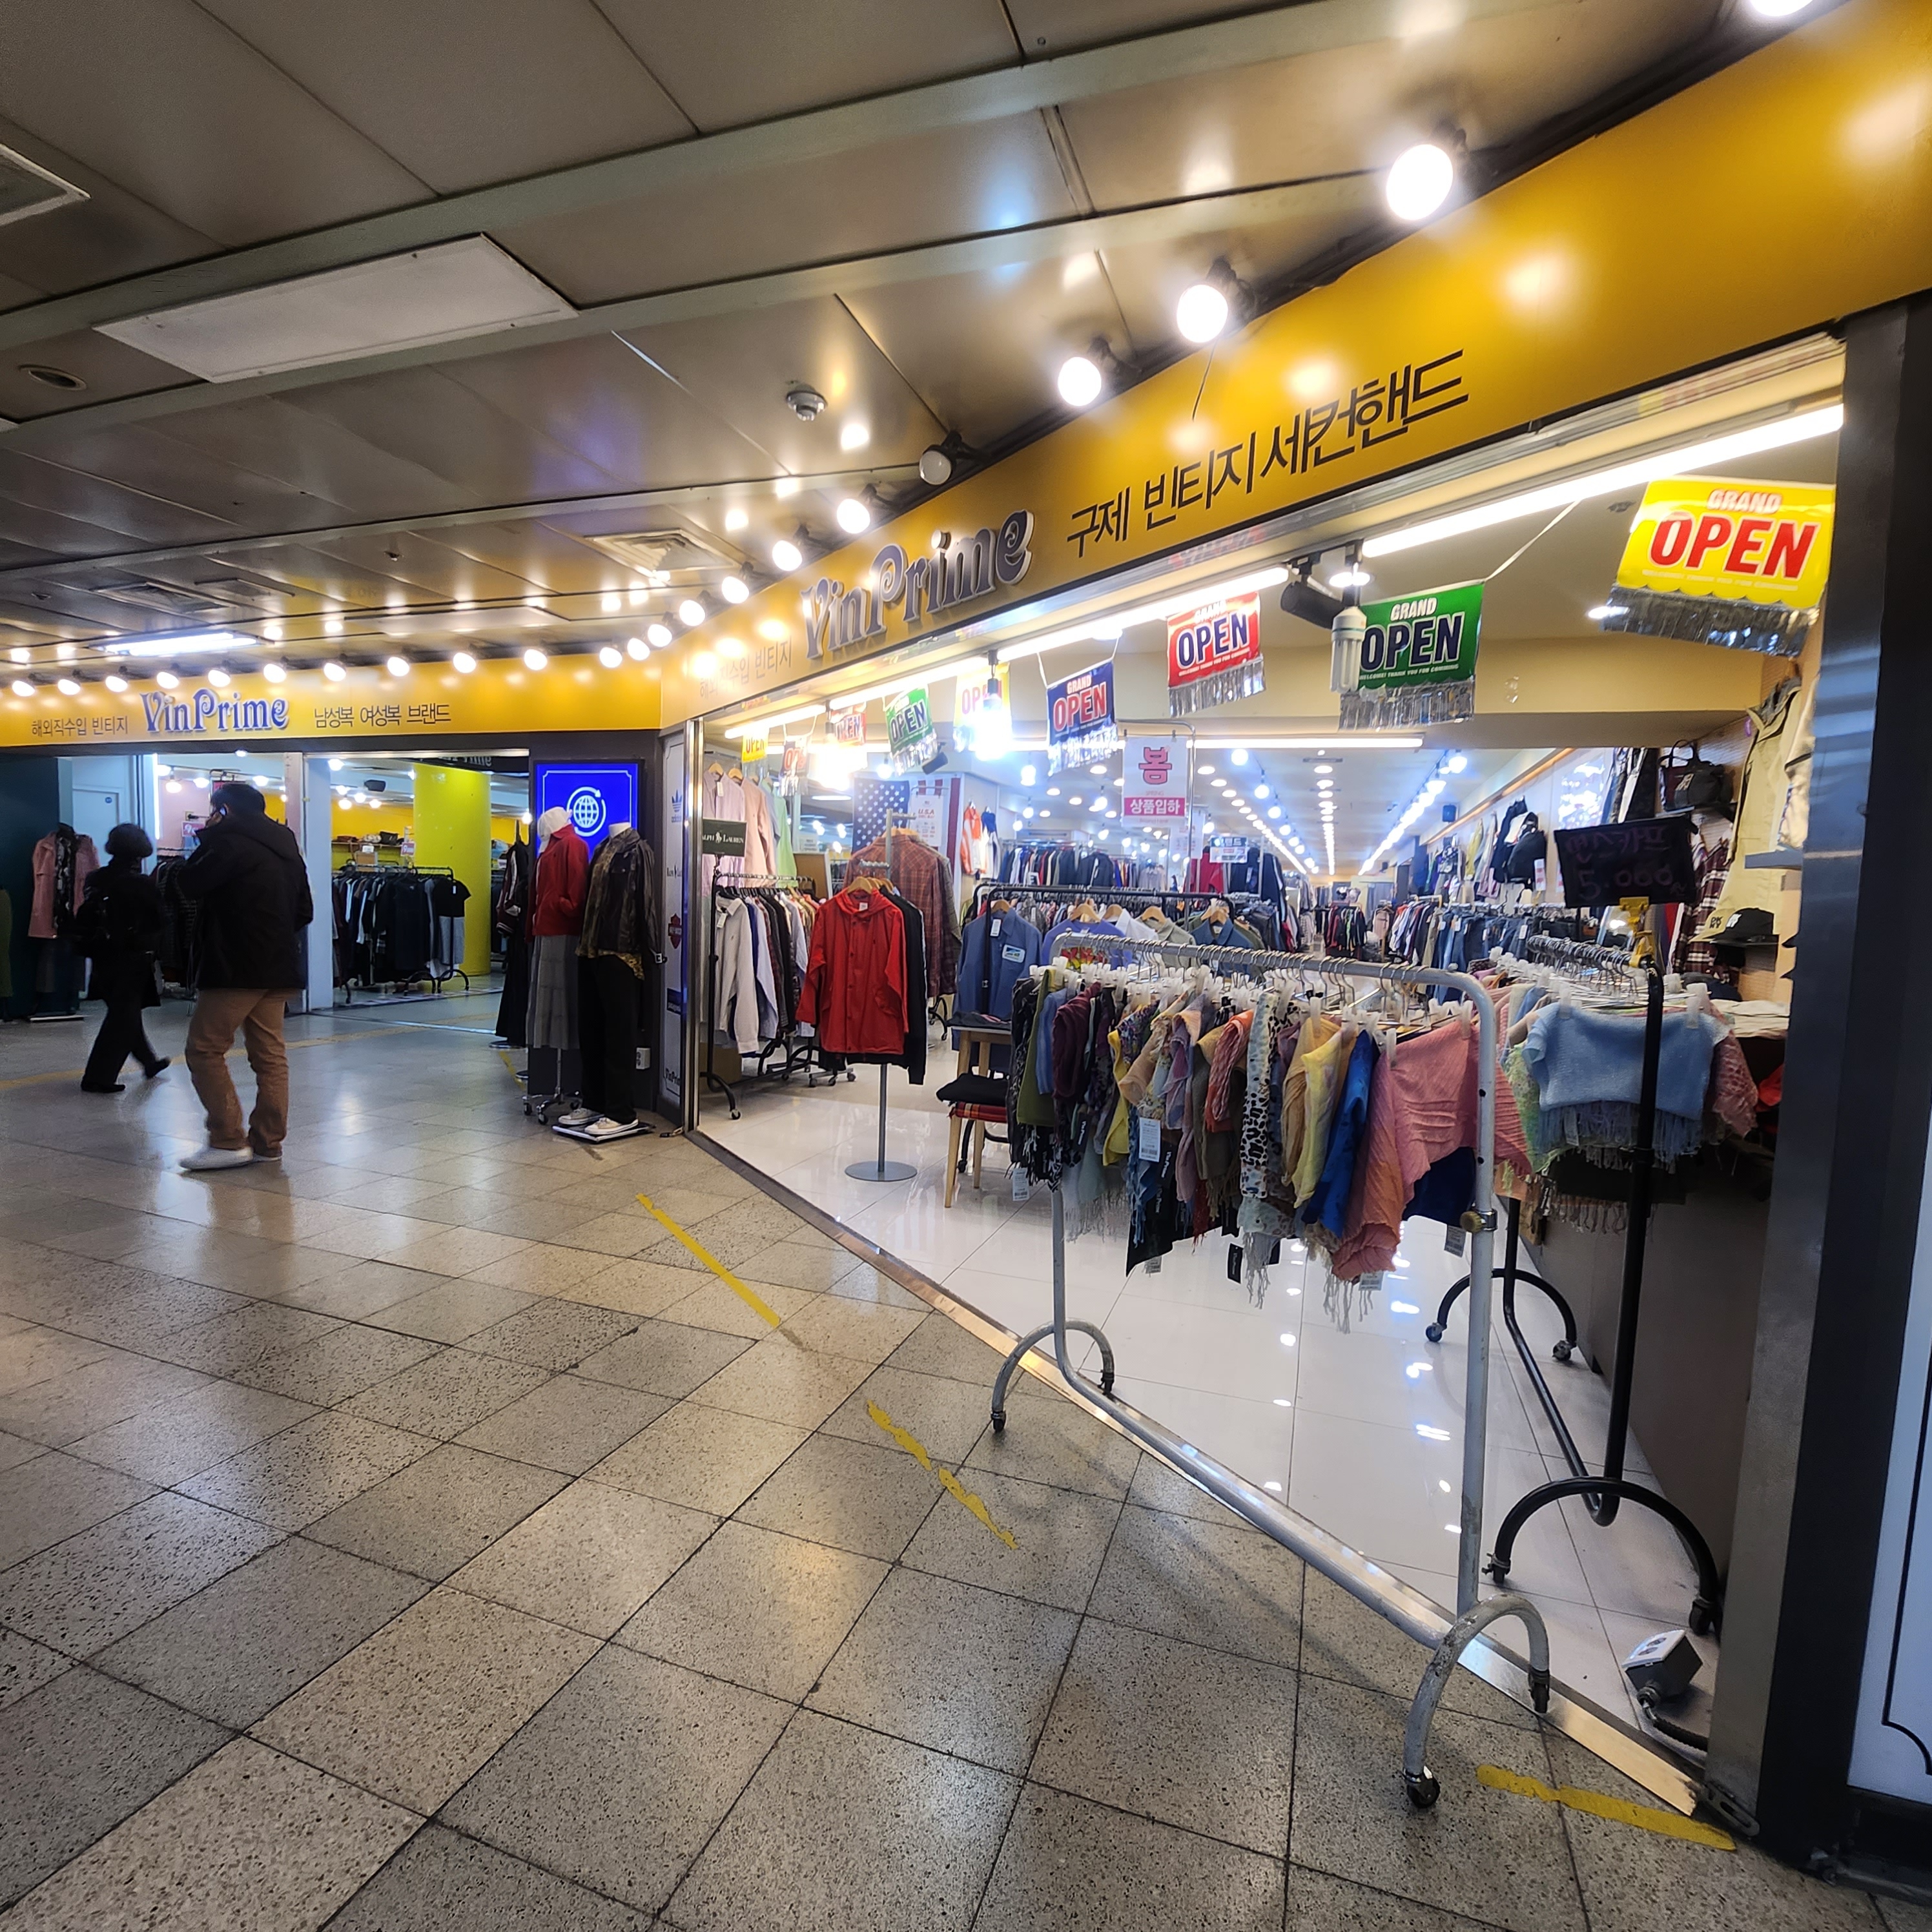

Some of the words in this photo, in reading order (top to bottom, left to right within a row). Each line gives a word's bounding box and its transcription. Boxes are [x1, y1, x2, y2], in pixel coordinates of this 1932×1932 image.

[1067, 486, 1131, 559] 구제
[1144, 431, 1258, 531] 빈티지
[1260, 349, 1470, 477] 세컨핸드
[1707, 489, 1783, 514] GRAND
[1649, 511, 1821, 581] OPEN
[800, 509, 1034, 660] VinPrime
[1390, 597, 1438, 621] GRAND
[755, 635, 792, 680] 빈티지
[1177, 611, 1250, 670] OPEN
[1361, 611, 1466, 672] OPEN
[1053, 681, 1107, 732] OPEN
[1067, 675, 1093, 695] GRAND
[31, 717, 88, 737] 해외직수입
[92, 715, 128, 736] 빈티지
[139, 688, 289, 734] VinPrime
[314, 706, 355, 728] 남성복
[360, 704, 402, 727] 여성복
[407, 703, 451, 724] 브랜드
[890, 699, 928, 743] OPEN
[1138, 746, 1172, 785] 봄
[1131, 799, 1180, 815] 상품입하
